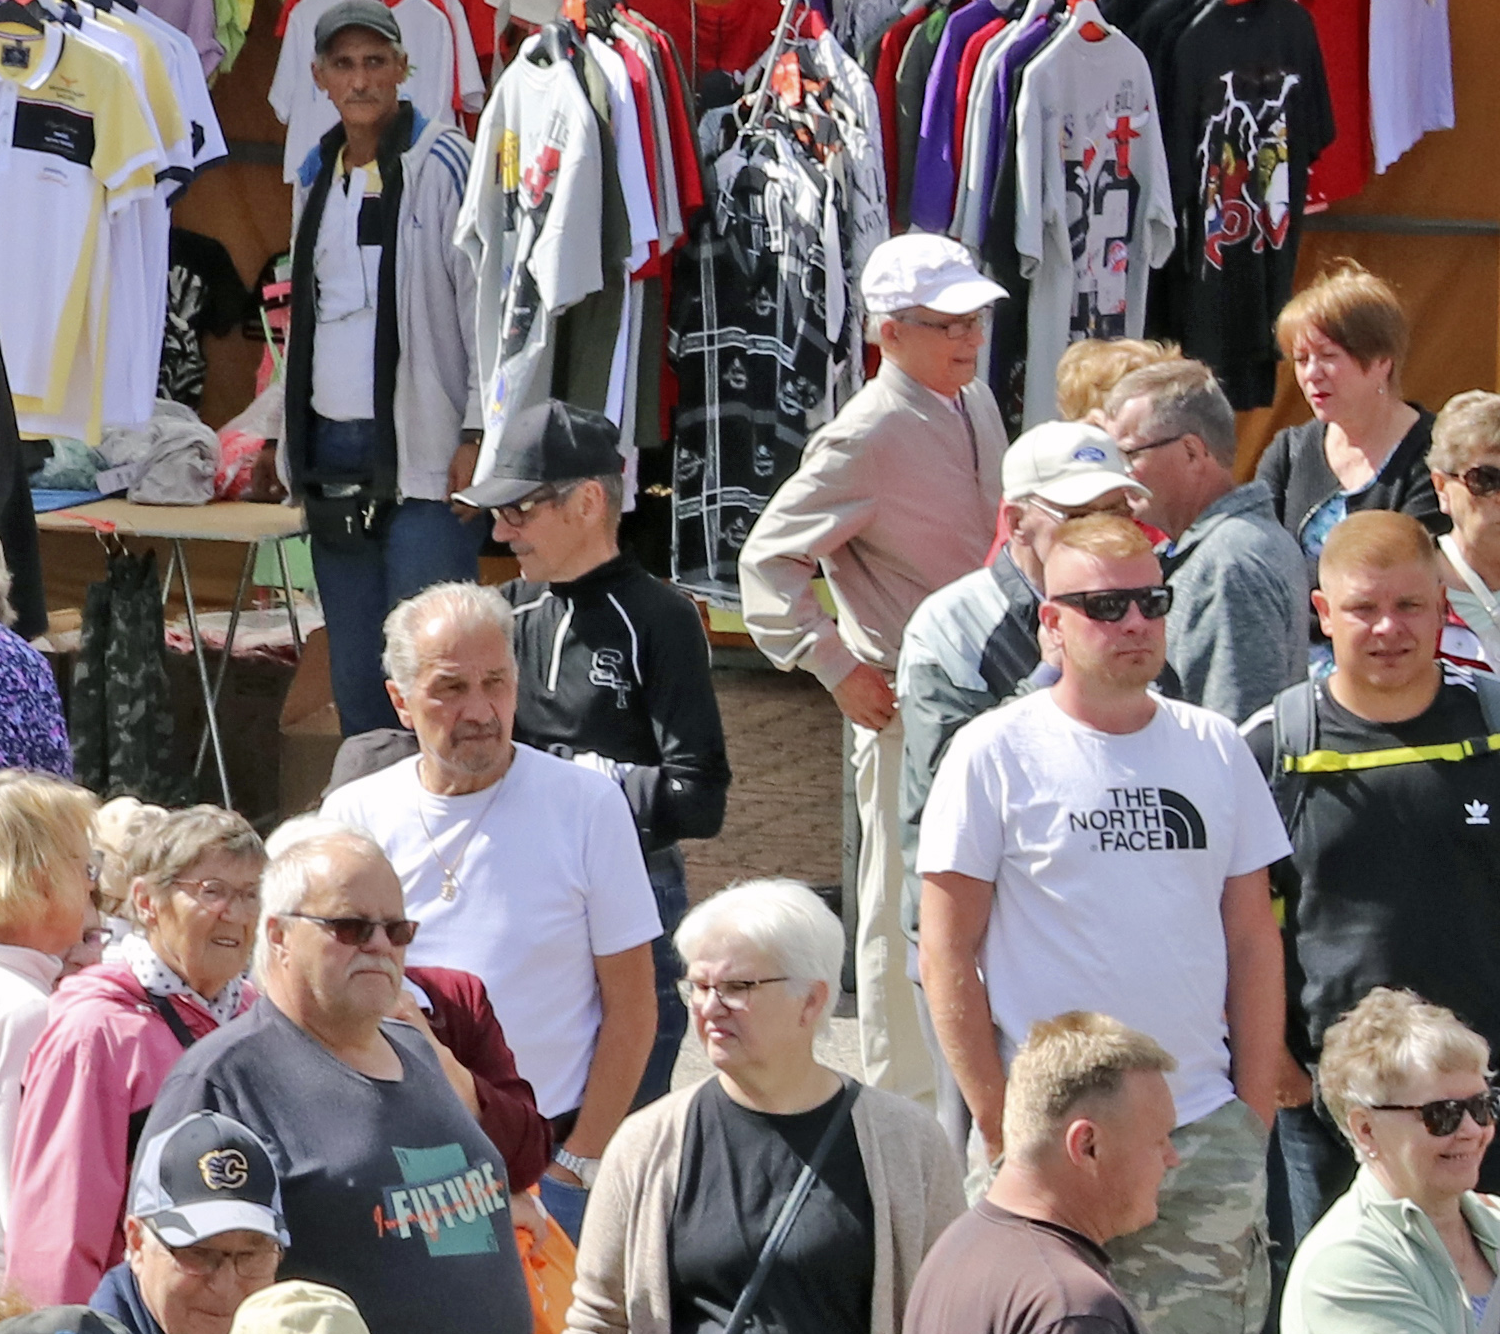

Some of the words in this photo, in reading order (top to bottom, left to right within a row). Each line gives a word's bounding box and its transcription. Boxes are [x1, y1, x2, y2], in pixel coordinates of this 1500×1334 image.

[1106, 787, 1158, 808] THE
[1069, 809, 1162, 833] NORTH
[1099, 830, 1164, 852] FACE
[390, 1162, 506, 1240] FUTURE
